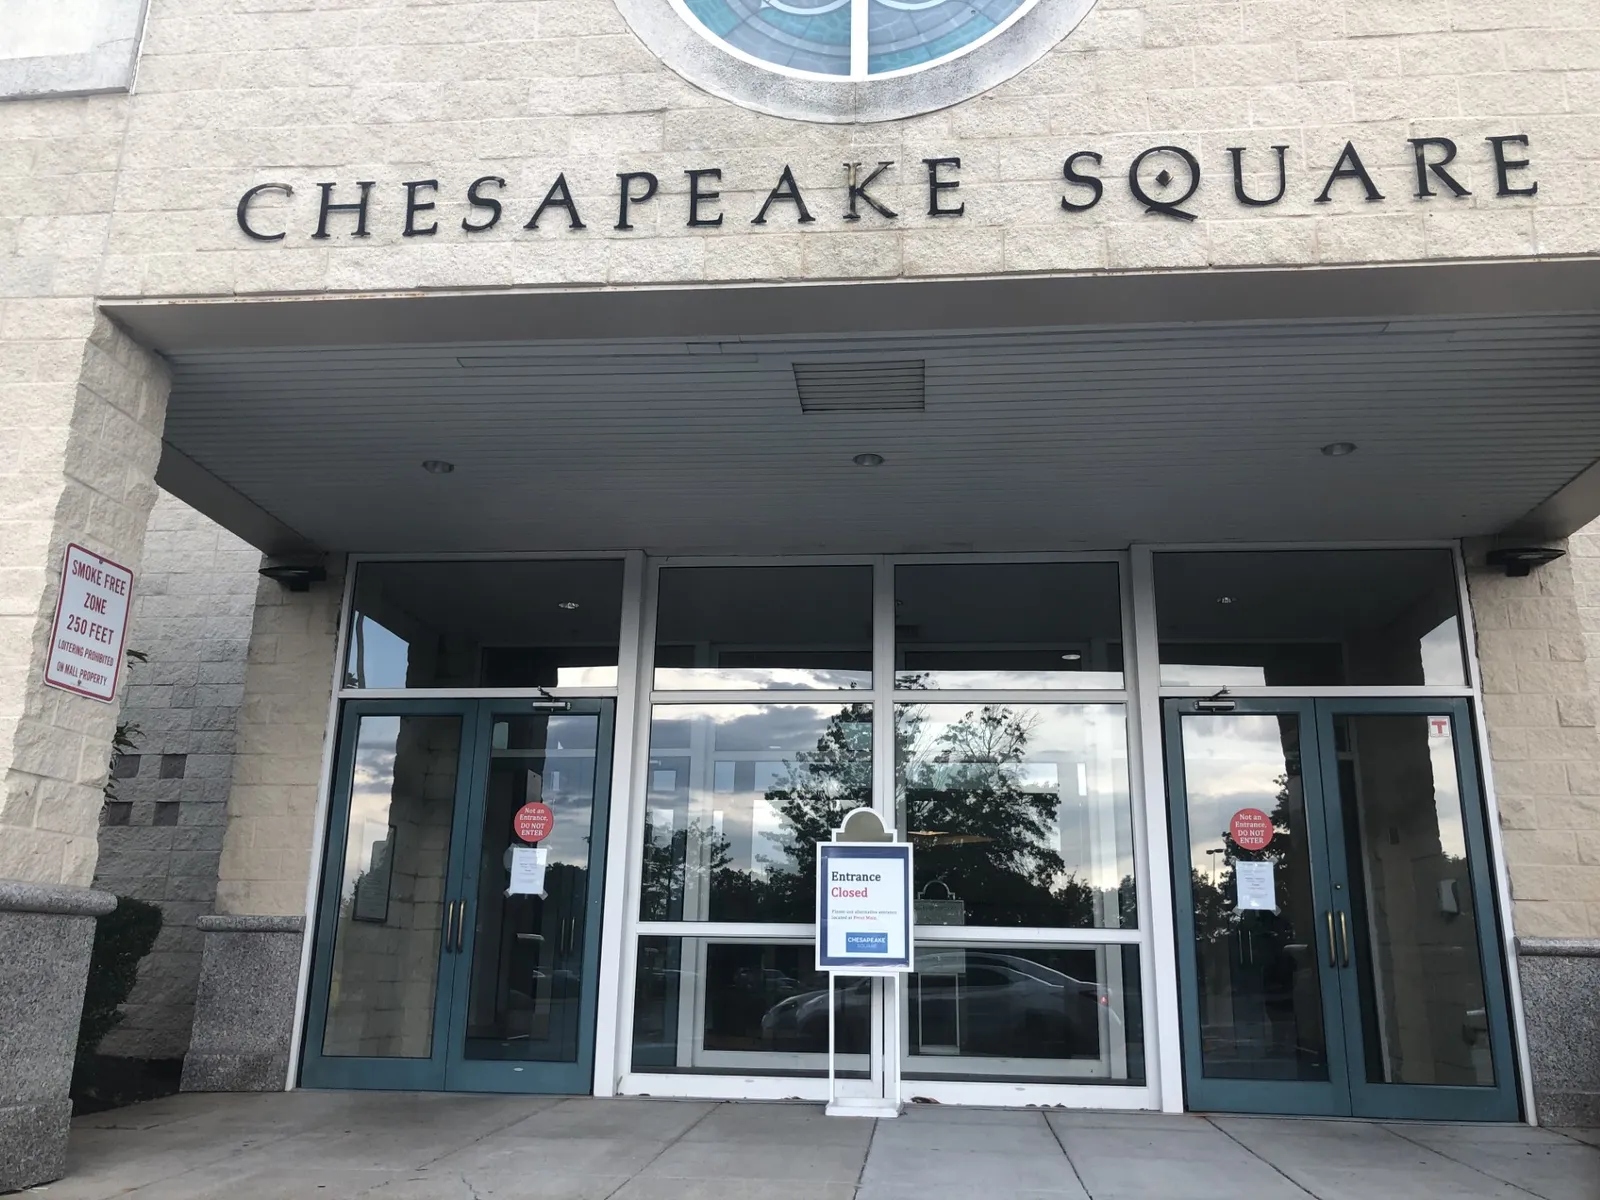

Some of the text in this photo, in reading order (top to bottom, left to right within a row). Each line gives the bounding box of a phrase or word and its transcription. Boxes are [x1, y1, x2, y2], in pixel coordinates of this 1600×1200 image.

[237, 134, 1538, 240] CHESAPEAKE SQUARE
[72, 559, 127, 596] SMOKE FREE
[84, 592, 107, 615] ZONE
[66, 614, 114, 645] 250 FEET
[58, 639, 114, 667] LOITERING PROHIBITED
[56, 661, 107, 686] ON MALL PROPERTY
[831, 871, 881, 882] Entrance
[831, 887, 868, 898] Closed
[847, 936, 886, 944] CHESAPEAKE
